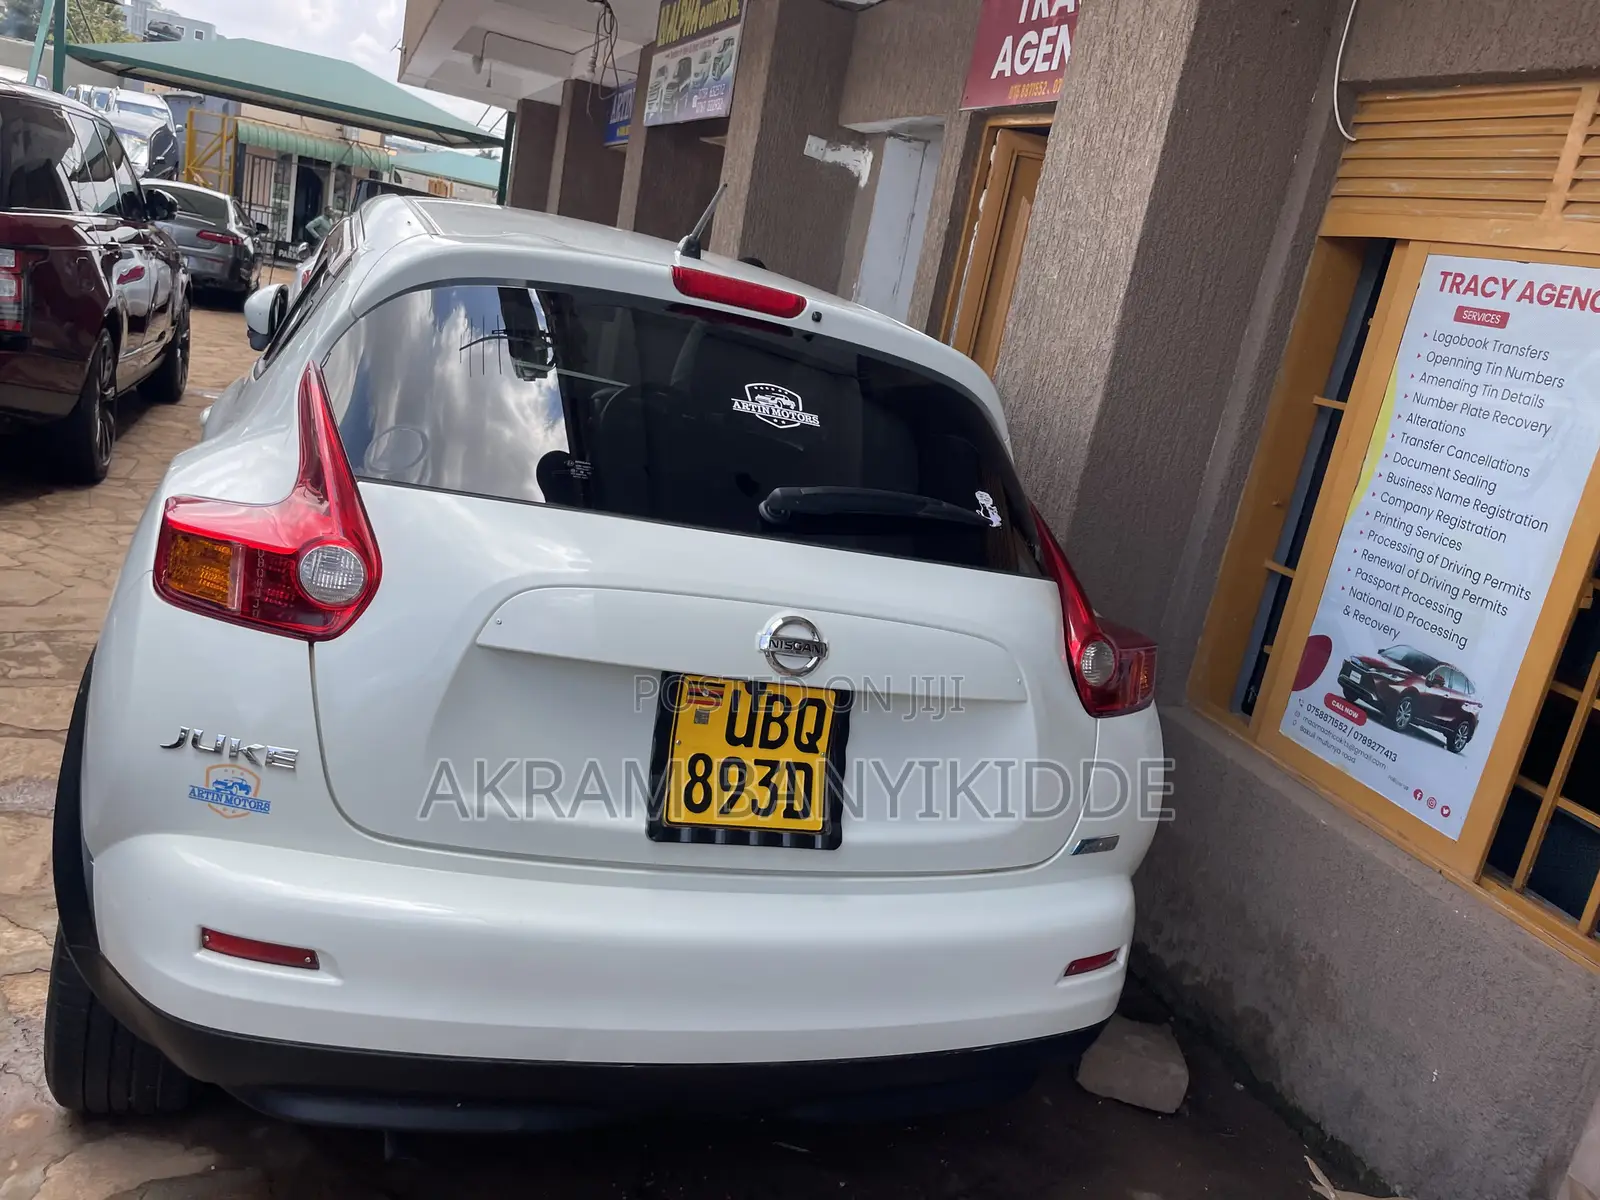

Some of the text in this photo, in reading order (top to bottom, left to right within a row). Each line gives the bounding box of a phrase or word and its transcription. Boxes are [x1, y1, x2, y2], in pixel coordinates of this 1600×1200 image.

[1439, 271, 1517, 300] TRACY
[1462, 310, 1501, 324] SERVICES
[1432, 330, 1550, 361] Logobook Transfers
[1419, 372, 1545, 409] Amending Tin Details
[1426, 351, 1564, 389] Openning Tin Numbers
[733, 401, 820, 424] ARTIN MOTORS
[1405, 413, 1466, 437] Alterations
[1413, 392, 1552, 437] Number Plate Recovery
[1393, 452, 1497, 496] Document Sealing
[1401, 432, 1530, 478] Transfer Cancellations
[1380, 492, 1507, 543] Company Registration
[1386, 472, 1548, 533] Business Name Registration
[1374, 510, 1463, 551] Printing Services
[1361, 549, 1508, 617] Renewal of Driving Permits
[1367, 530, 1532, 601] Processing of Driving Permits
[1355, 567, 1462, 624] Passport Processing
[1342, 605, 1400, 641] & Recovery
[1349, 586, 1468, 650] National ID Processing
[769, 639, 824, 655] NISSAN
[725, 690, 826, 754] UBQ
[1331, 699, 1359, 719] CALL NOW
[159, 726, 299, 768] JUKE
[1306, 703, 1348, 734] 0758871552
[1353, 731, 1398, 762] 0789277413
[189, 787, 271, 812] ARTIN MOTORS
